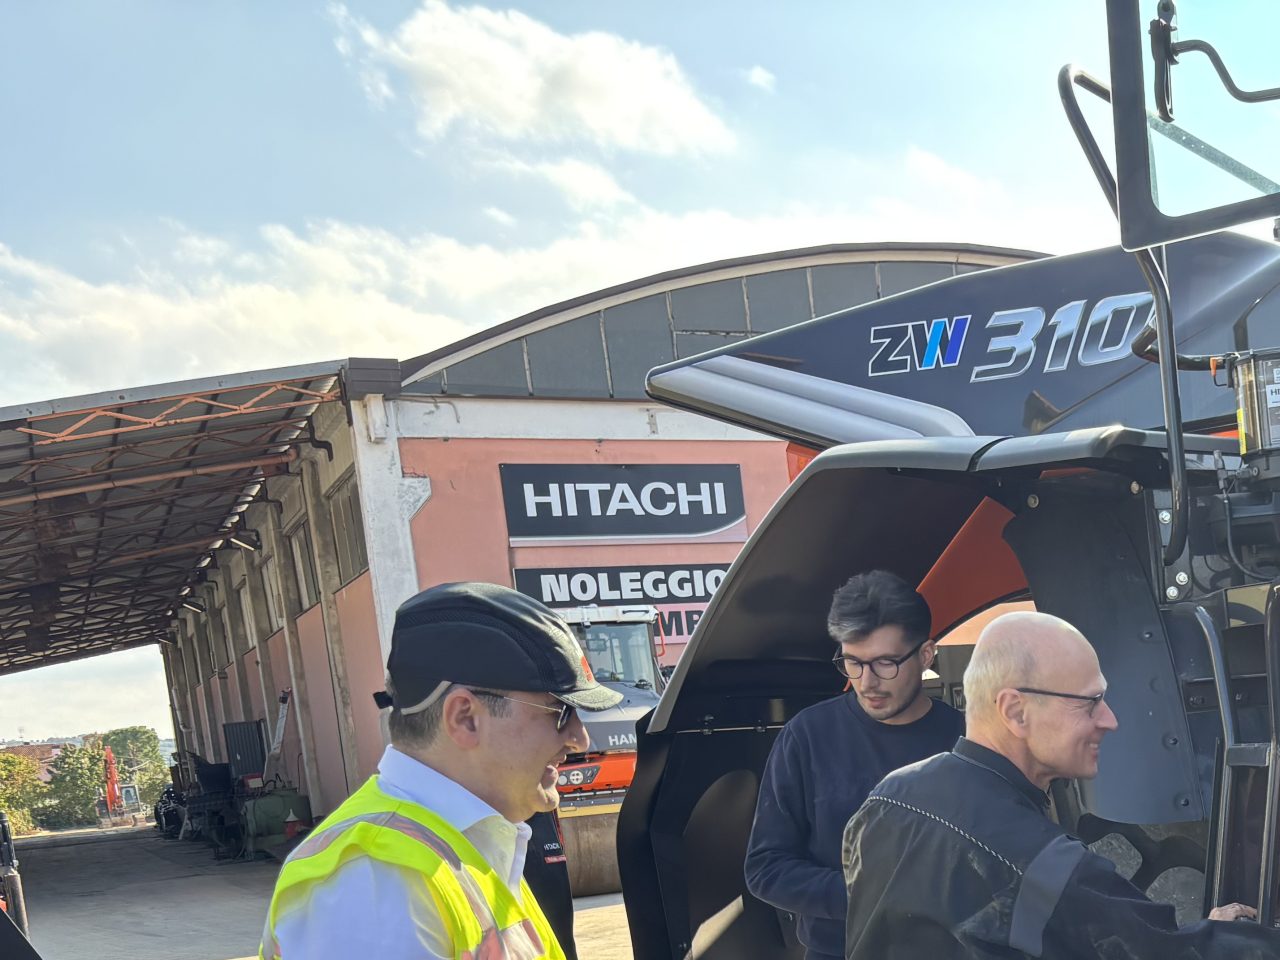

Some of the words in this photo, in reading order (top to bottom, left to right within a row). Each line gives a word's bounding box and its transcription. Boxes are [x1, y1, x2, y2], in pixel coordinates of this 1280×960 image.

[868, 315, 972, 377] ZW
[970, 291, 1156, 383] 310
[523, 481, 727, 518] HITACHI
[540, 569, 727, 603] NOLEGGIO
